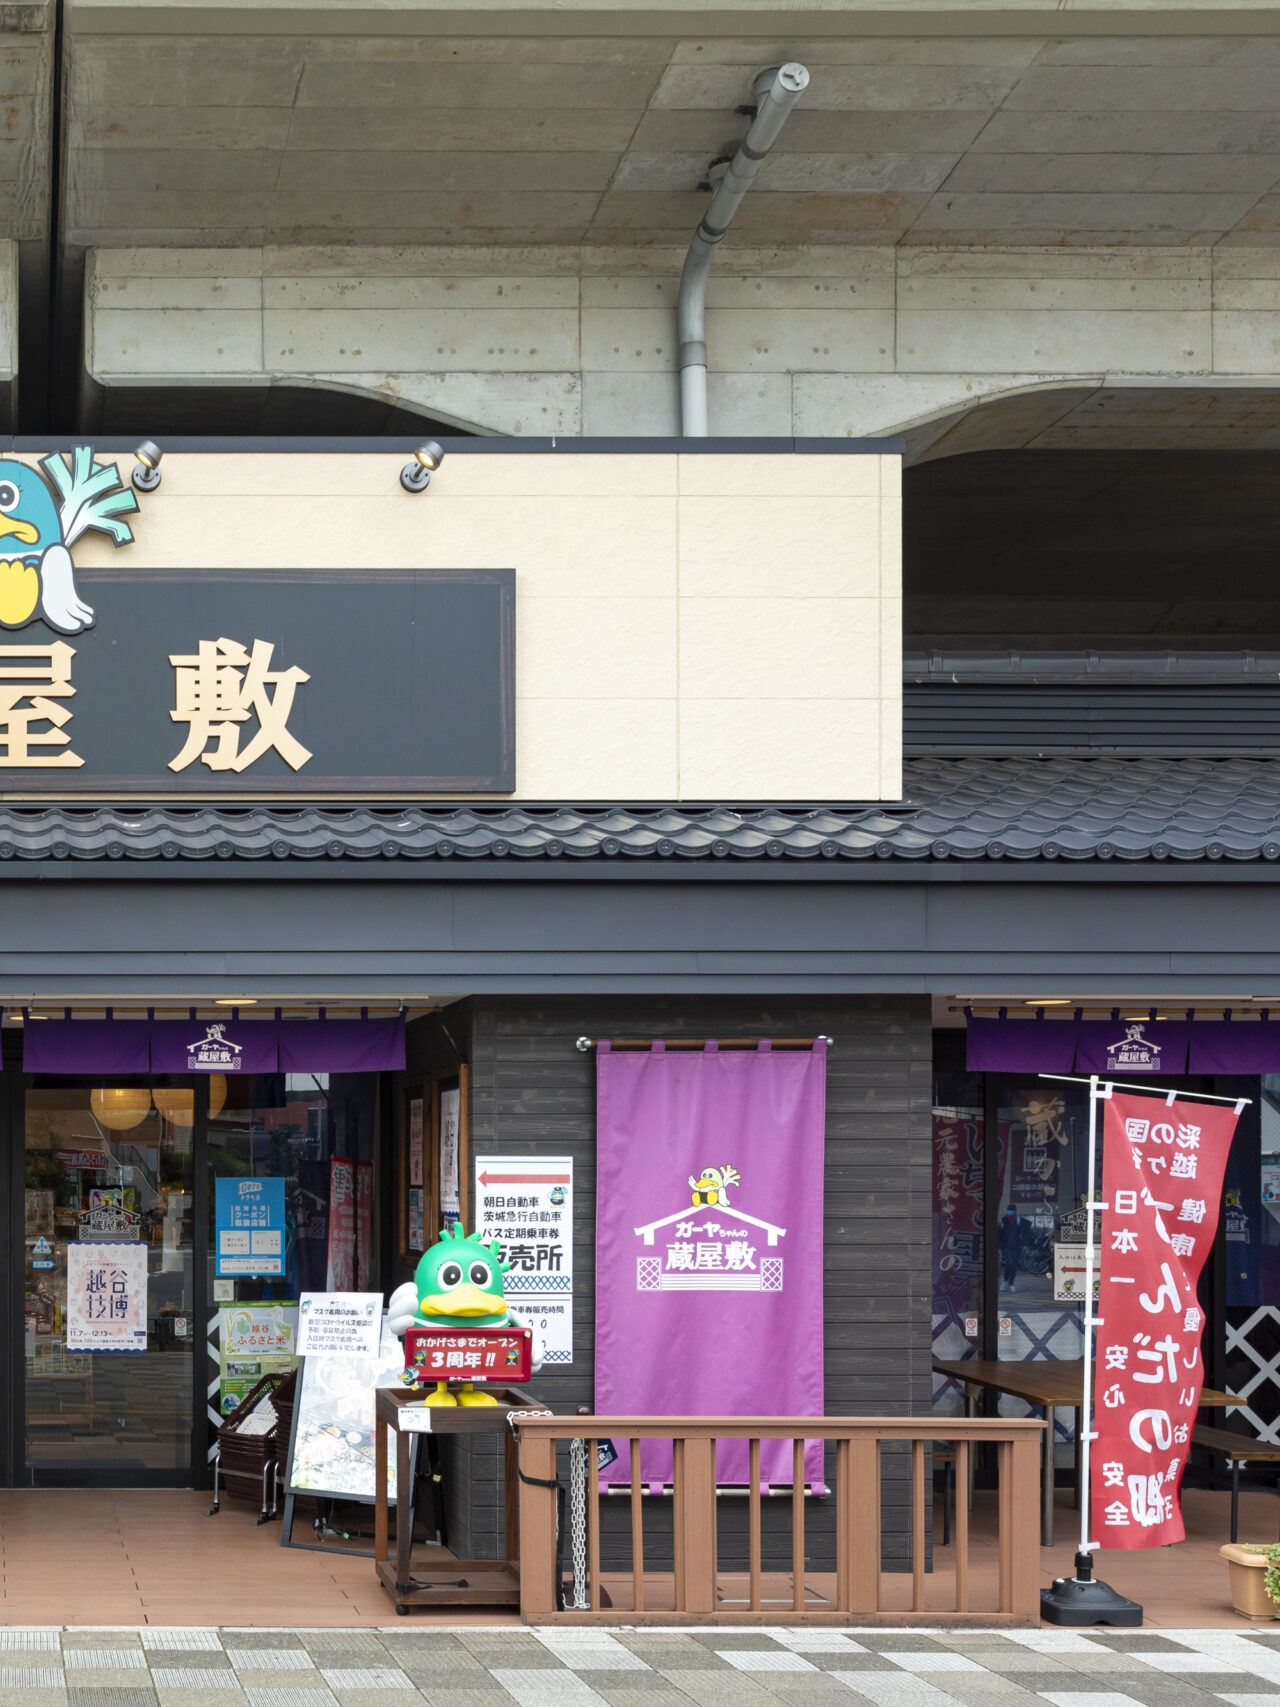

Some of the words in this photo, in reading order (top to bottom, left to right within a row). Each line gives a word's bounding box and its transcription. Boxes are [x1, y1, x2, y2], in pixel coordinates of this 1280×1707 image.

[198, 1051, 231, 1062] 蔵屋敷
[1118, 1052, 1150, 1063] 蔵屋敷
[483, 1196, 540, 1208] 朝日自動車
[483, 1211, 562, 1222] 茨城急行自動車
[482, 1228, 560, 1239] バス定期乗車券
[675, 1221, 748, 1238] ガーヤちゃんの
[665, 1241, 757, 1271] 蔵屋敷
[86, 1269, 128, 1293] 越谷
[86, 1295, 128, 1319] 技博
[508, 1305, 564, 1313] 車券販売時間
[251, 1324, 270, 1333] 越谷
[237, 1335, 286, 1345] ふるさと米
[416, 1337, 518, 1348] おかげさまでオープン
